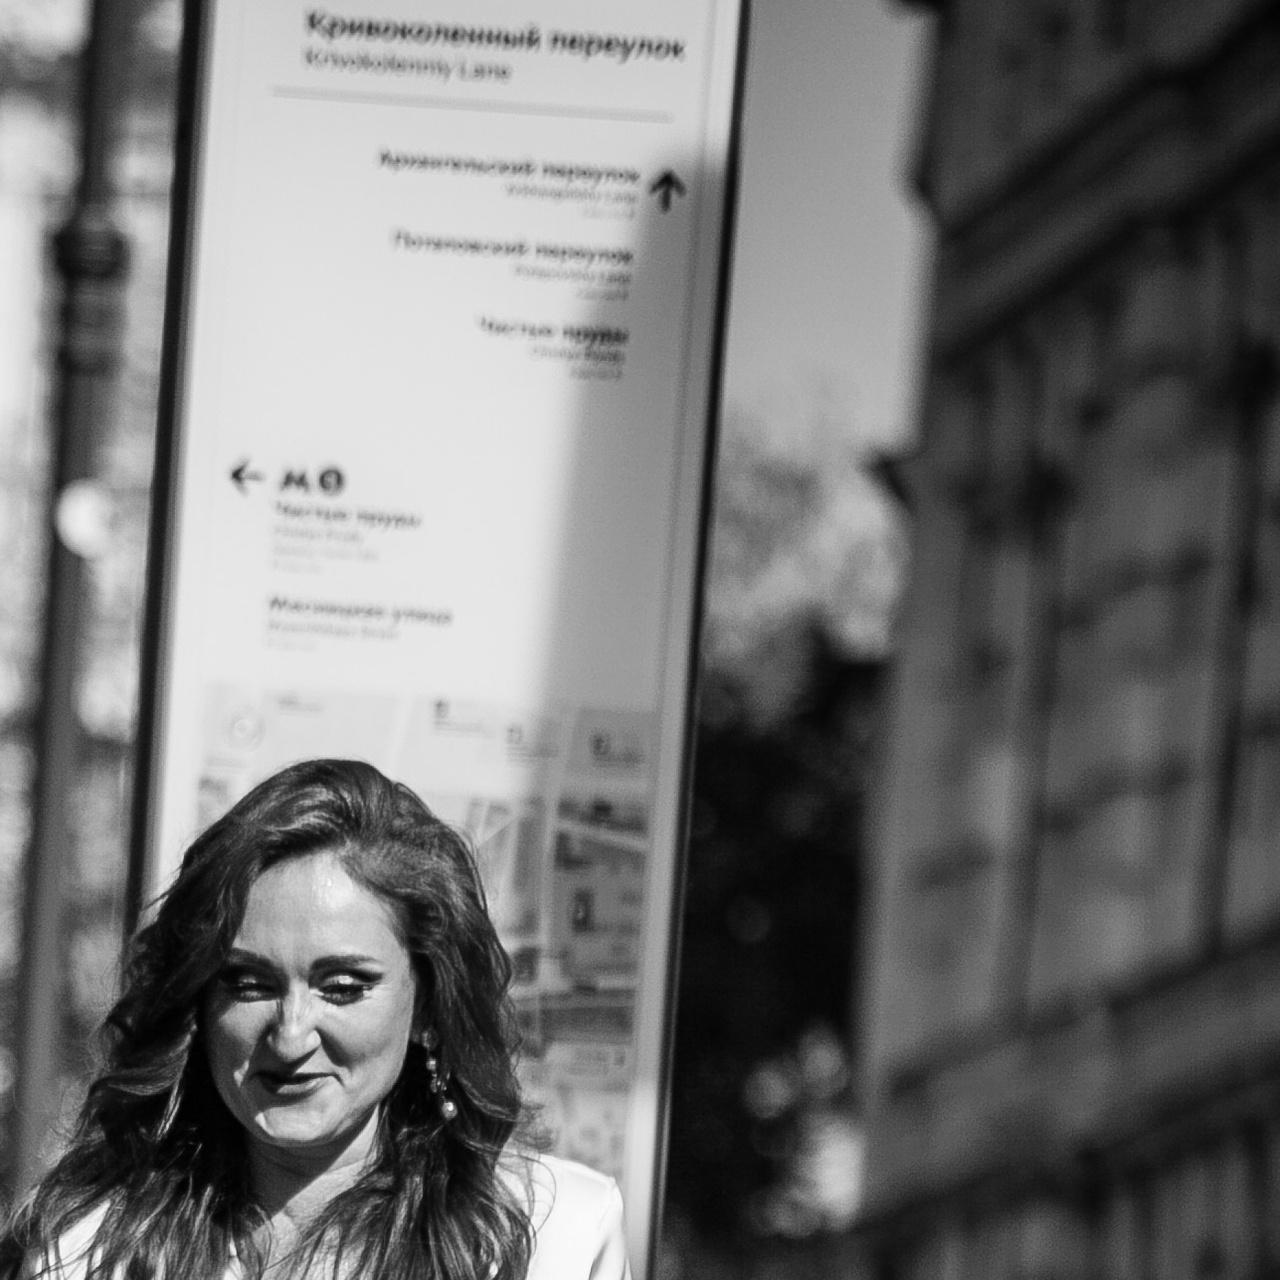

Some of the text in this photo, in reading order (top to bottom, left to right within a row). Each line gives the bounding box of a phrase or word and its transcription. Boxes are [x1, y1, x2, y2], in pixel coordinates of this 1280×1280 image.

[303, 8, 686, 65] Кривоколенный переулок
[458, 57, 513, 82] Lane
